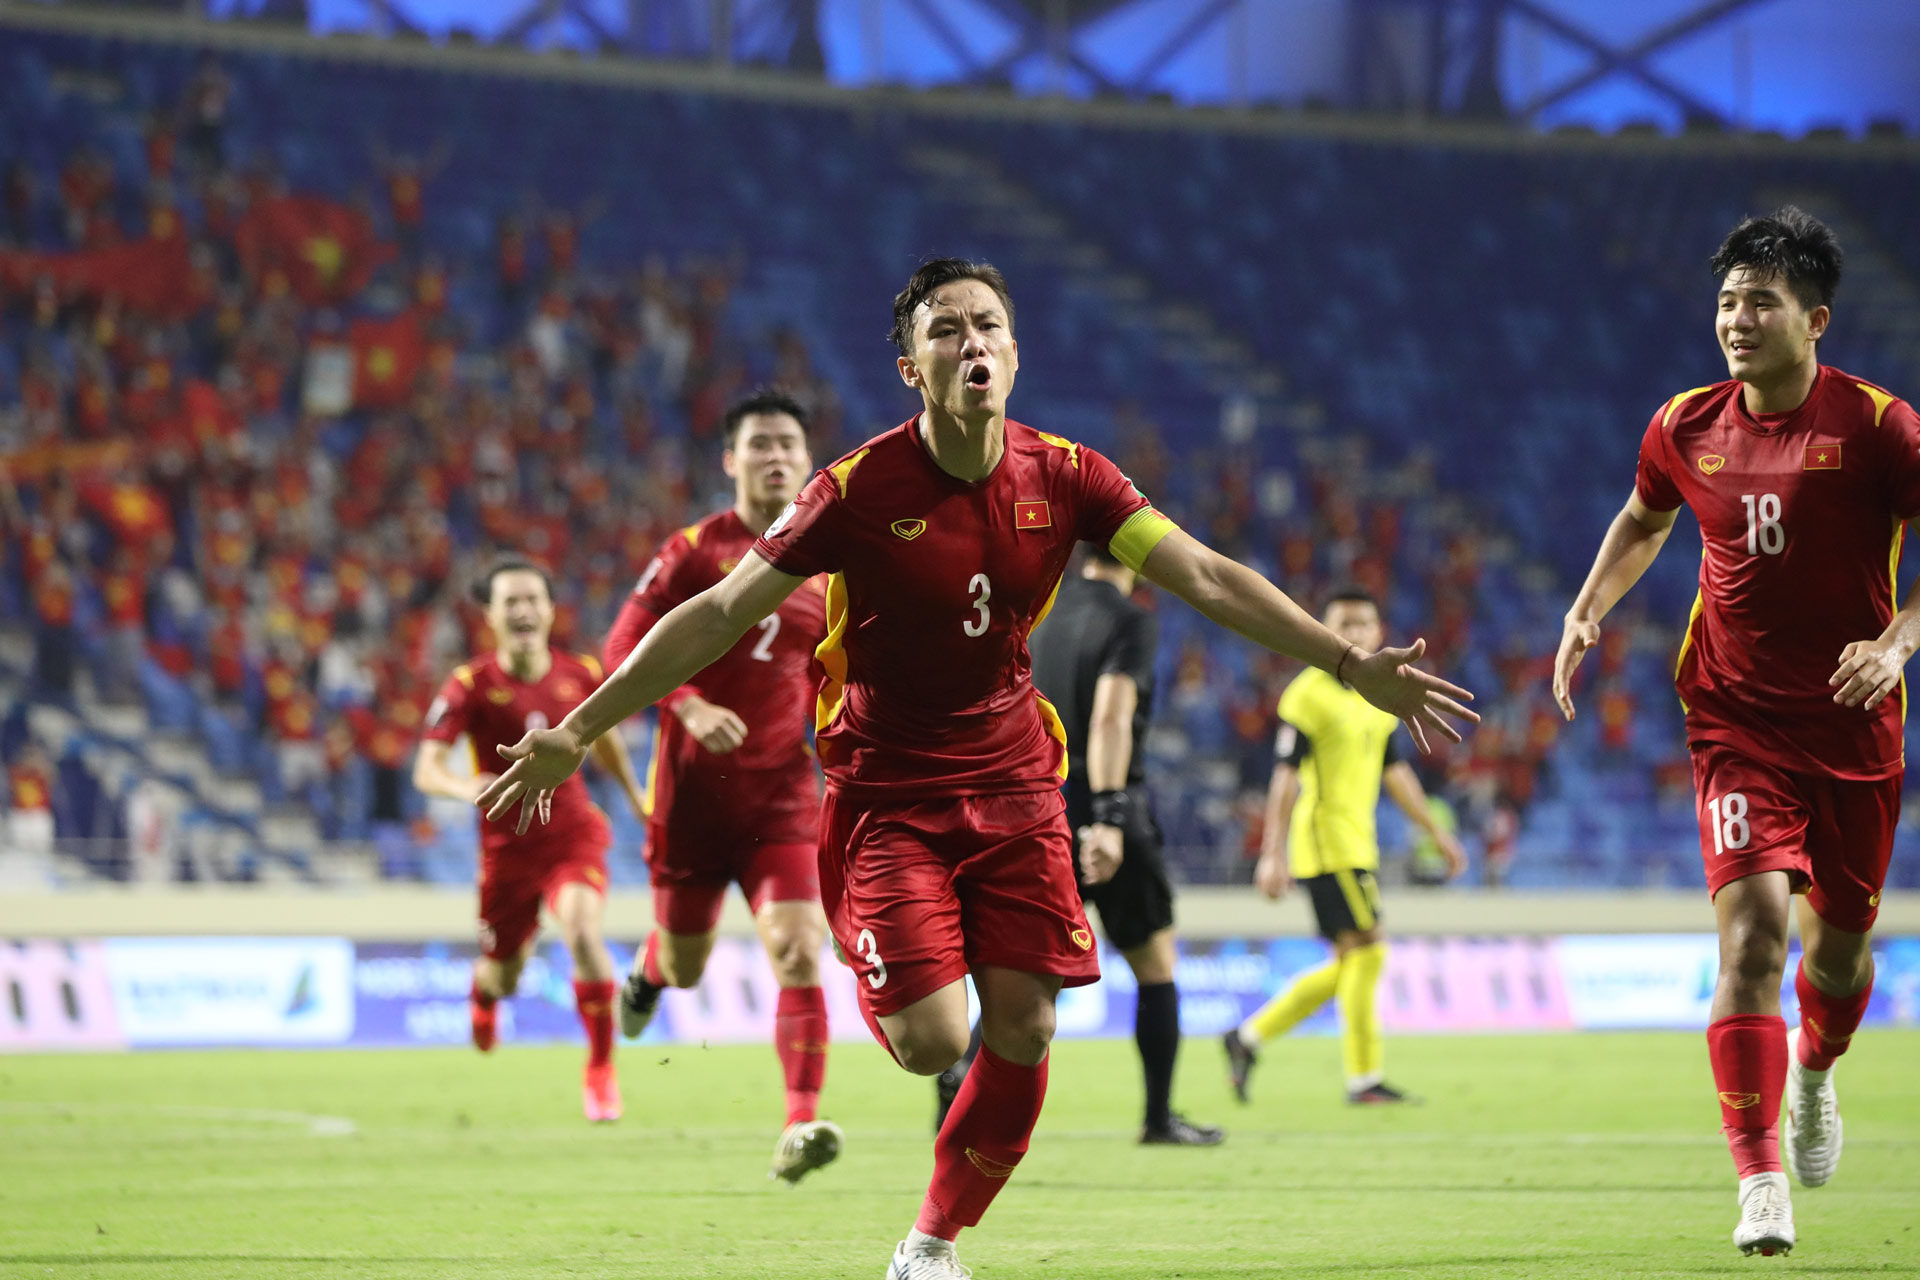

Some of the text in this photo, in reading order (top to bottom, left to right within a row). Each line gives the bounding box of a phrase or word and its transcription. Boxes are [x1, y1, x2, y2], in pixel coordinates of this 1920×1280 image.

[1741, 493, 1785, 555] 18
[963, 573, 991, 637] 3
[751, 612, 782, 663] 2
[1708, 792, 1751, 856] 18
[857, 928, 888, 989] 3
